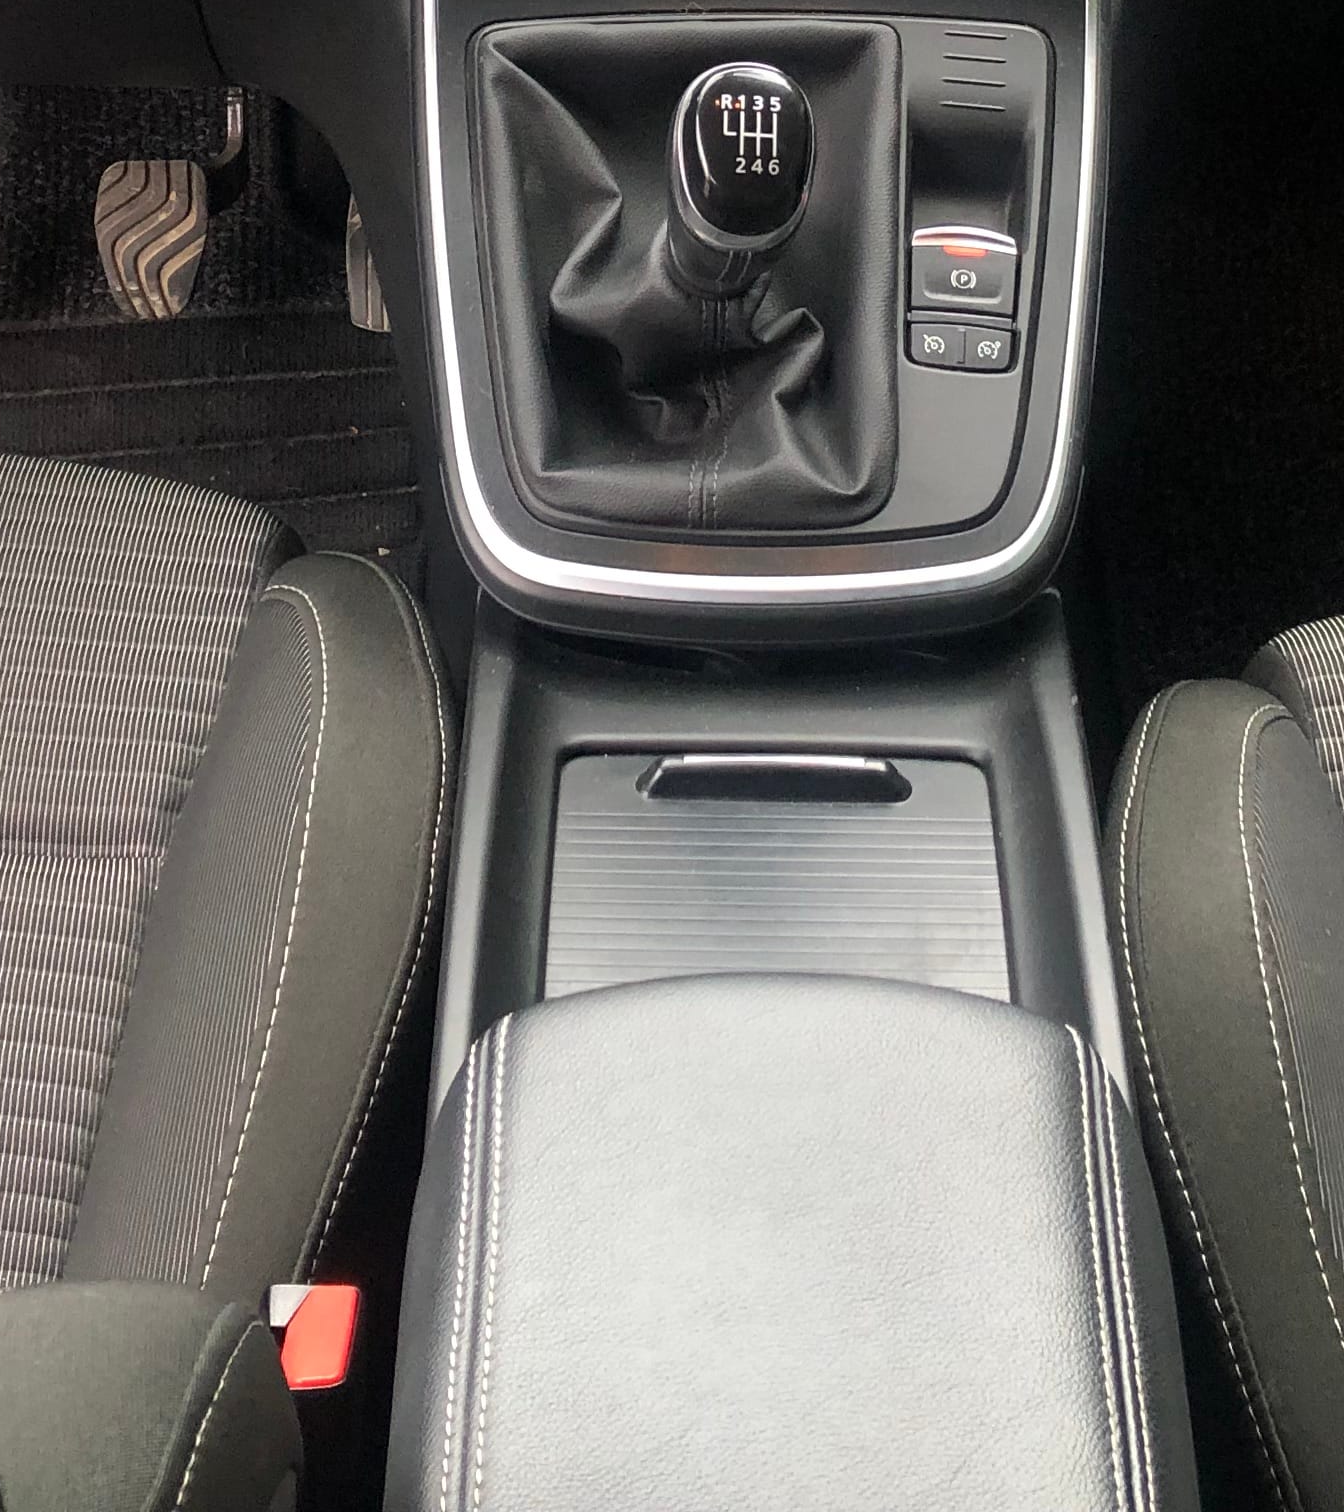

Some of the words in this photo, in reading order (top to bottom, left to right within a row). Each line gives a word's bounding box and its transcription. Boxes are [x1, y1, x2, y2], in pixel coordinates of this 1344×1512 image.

[720, 93, 733, 110] R
[737, 94, 746, 110] 1
[752, 95, 765, 111] 3
[769, 96, 782, 112] 5
[735, 156, 747, 174] 2
[751, 158, 764, 175] 4
[768, 159, 780, 176] 6
